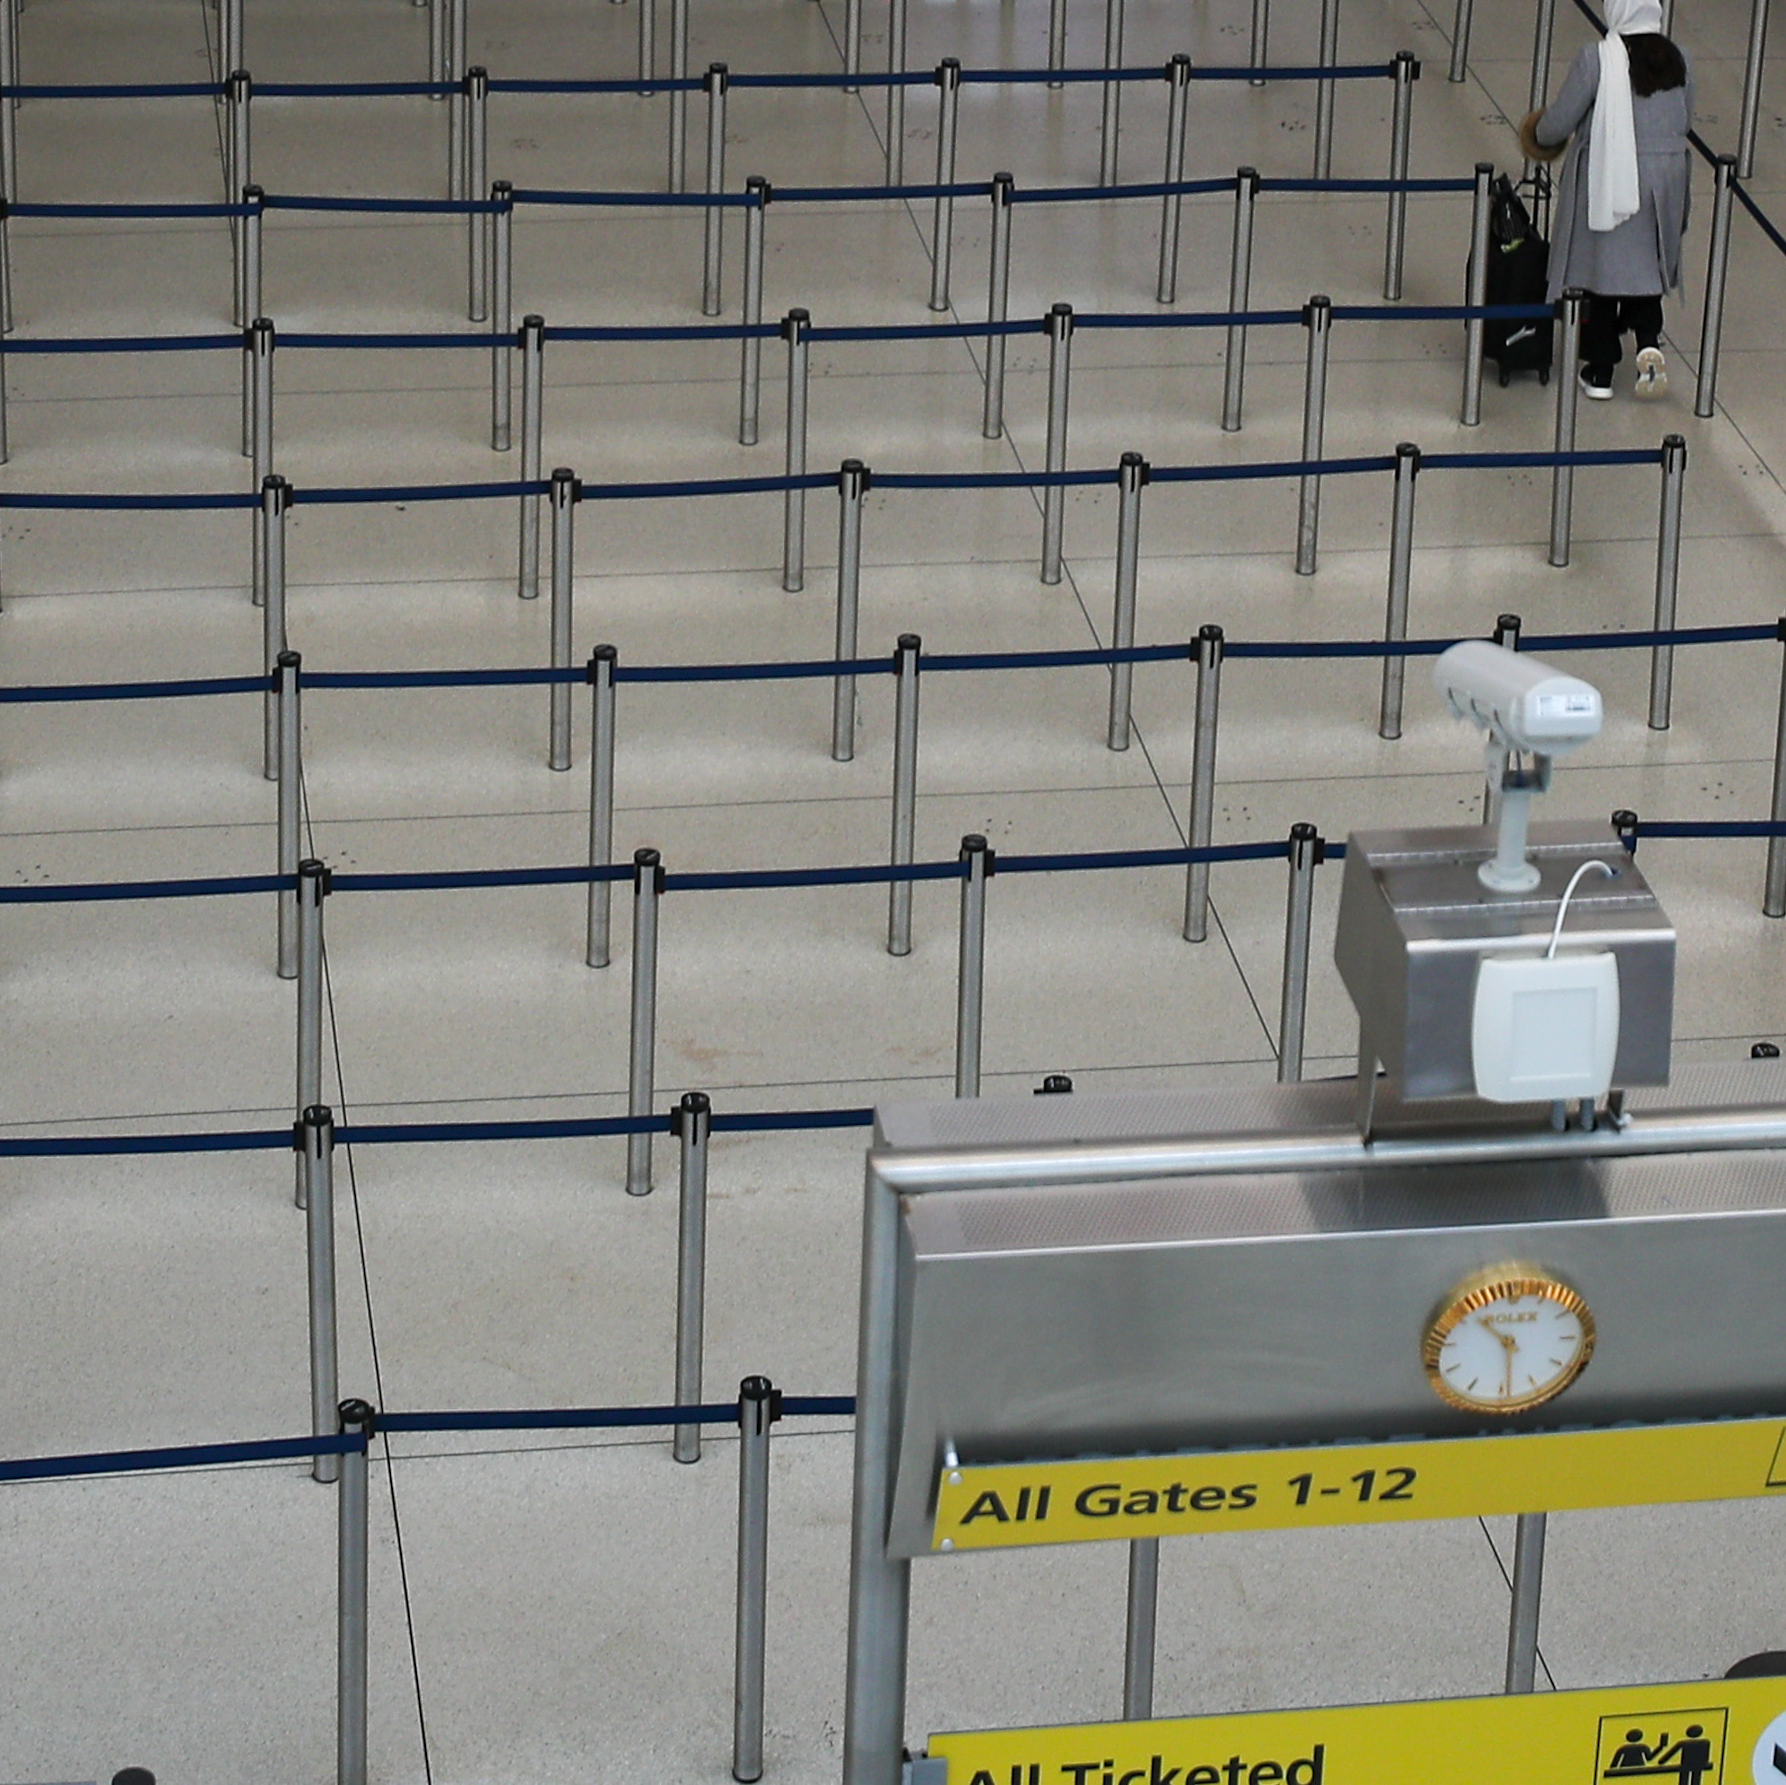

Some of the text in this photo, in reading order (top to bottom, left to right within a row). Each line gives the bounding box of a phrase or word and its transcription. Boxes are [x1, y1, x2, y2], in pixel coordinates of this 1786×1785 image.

[959, 1465, 1417, 1526] All Gates 1-12
